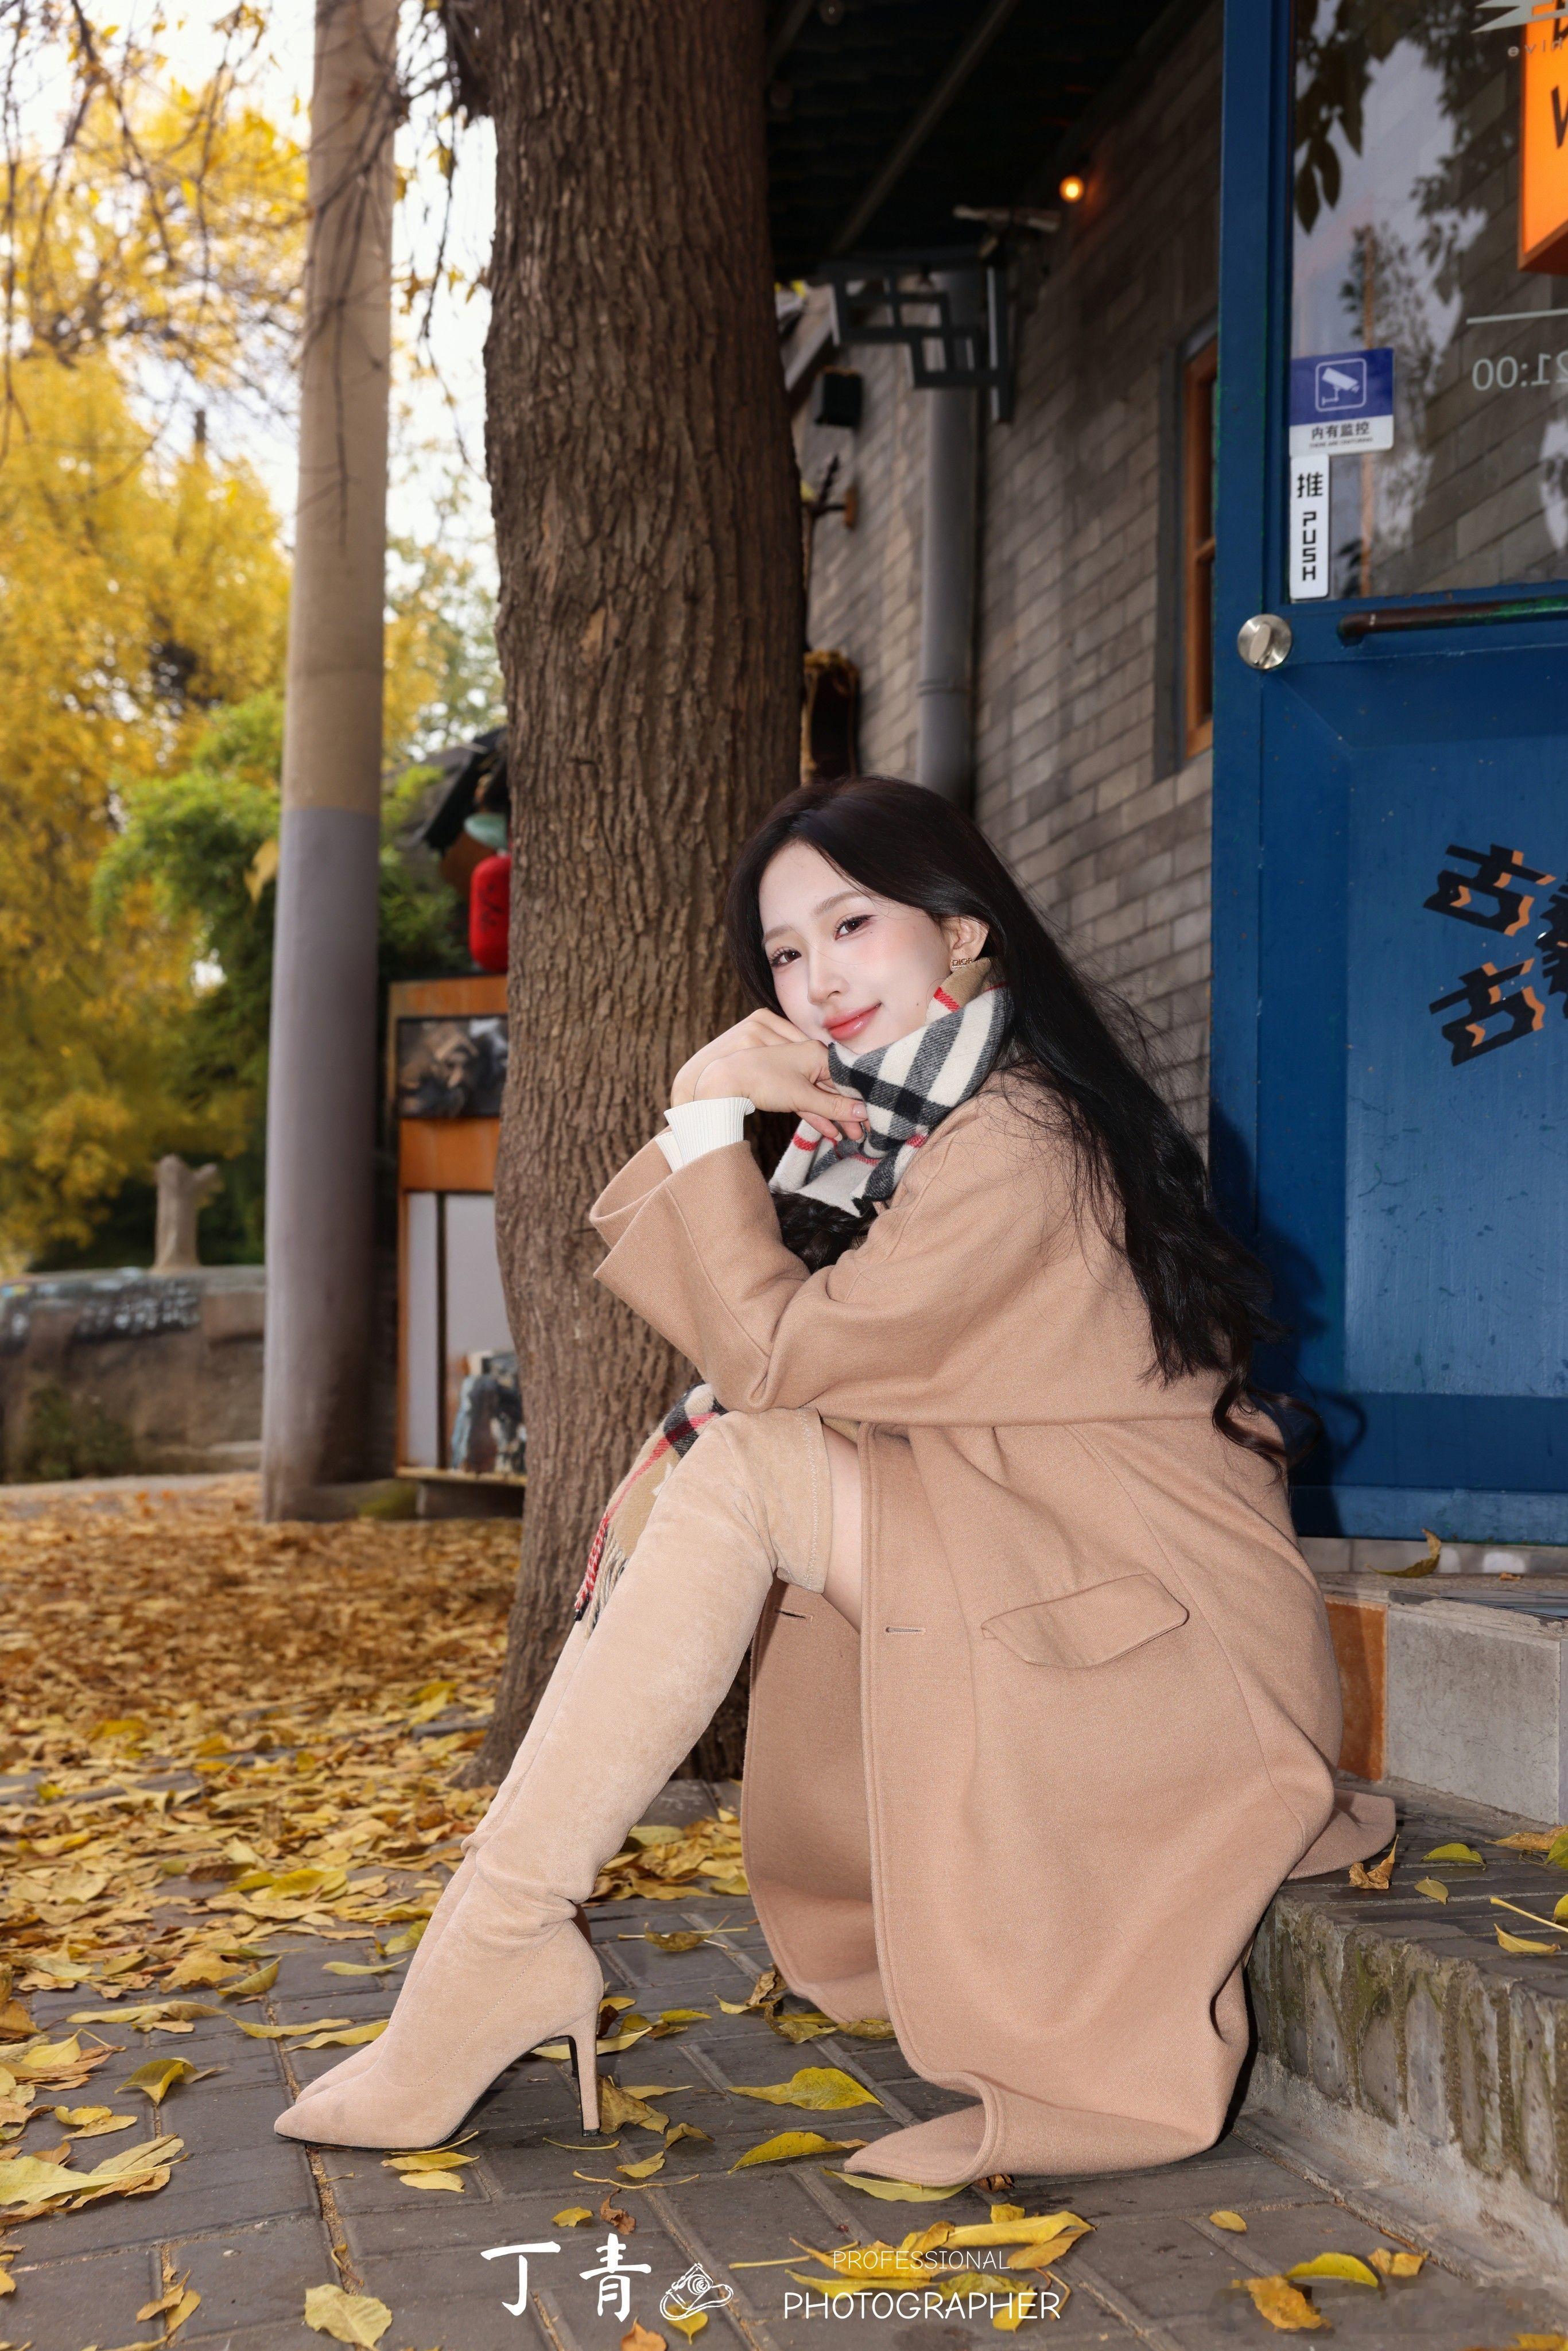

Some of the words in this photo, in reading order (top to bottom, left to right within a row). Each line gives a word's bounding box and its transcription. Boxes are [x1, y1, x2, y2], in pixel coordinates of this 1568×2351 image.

[1311, 421, 1370, 440] 内有监控
[1297, 473, 1323, 498] 推
[1302, 511, 1317, 581] PUSH
